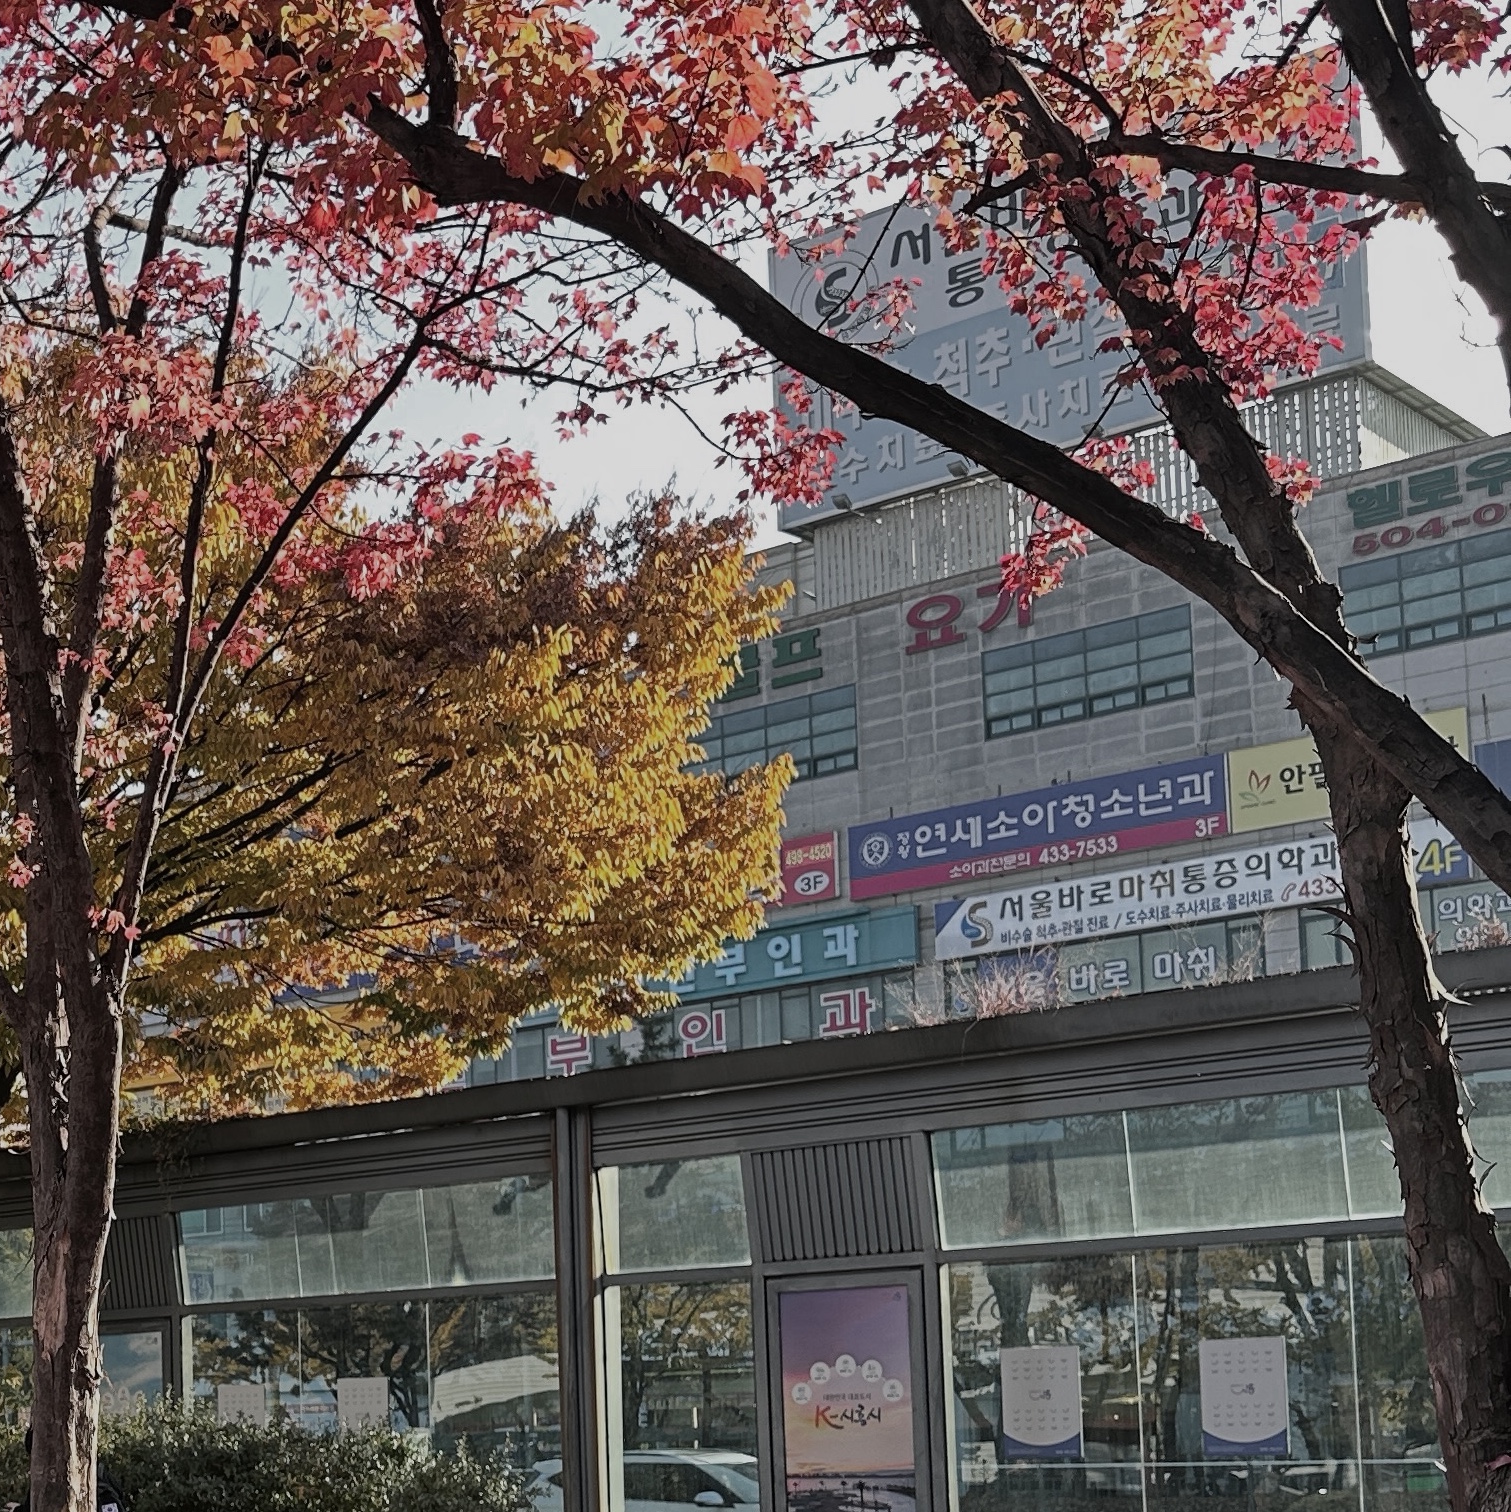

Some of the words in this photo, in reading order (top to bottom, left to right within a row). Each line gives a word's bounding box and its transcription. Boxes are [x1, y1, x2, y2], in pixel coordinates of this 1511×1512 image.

[1353, 502, 1511, 555] 504-0
[914, 769, 1215, 859] 연세소아청소년과
[949, 852, 1031, 879] 소아과전문의
[1038, 835, 1119, 865] 433-7533
[1194, 815, 1220, 838] 3F
[1416, 839, 1462, 876] 4F
[800, 873, 824, 893] 3F
[999, 841, 1338, 921] 서울바로마취통증의학과
